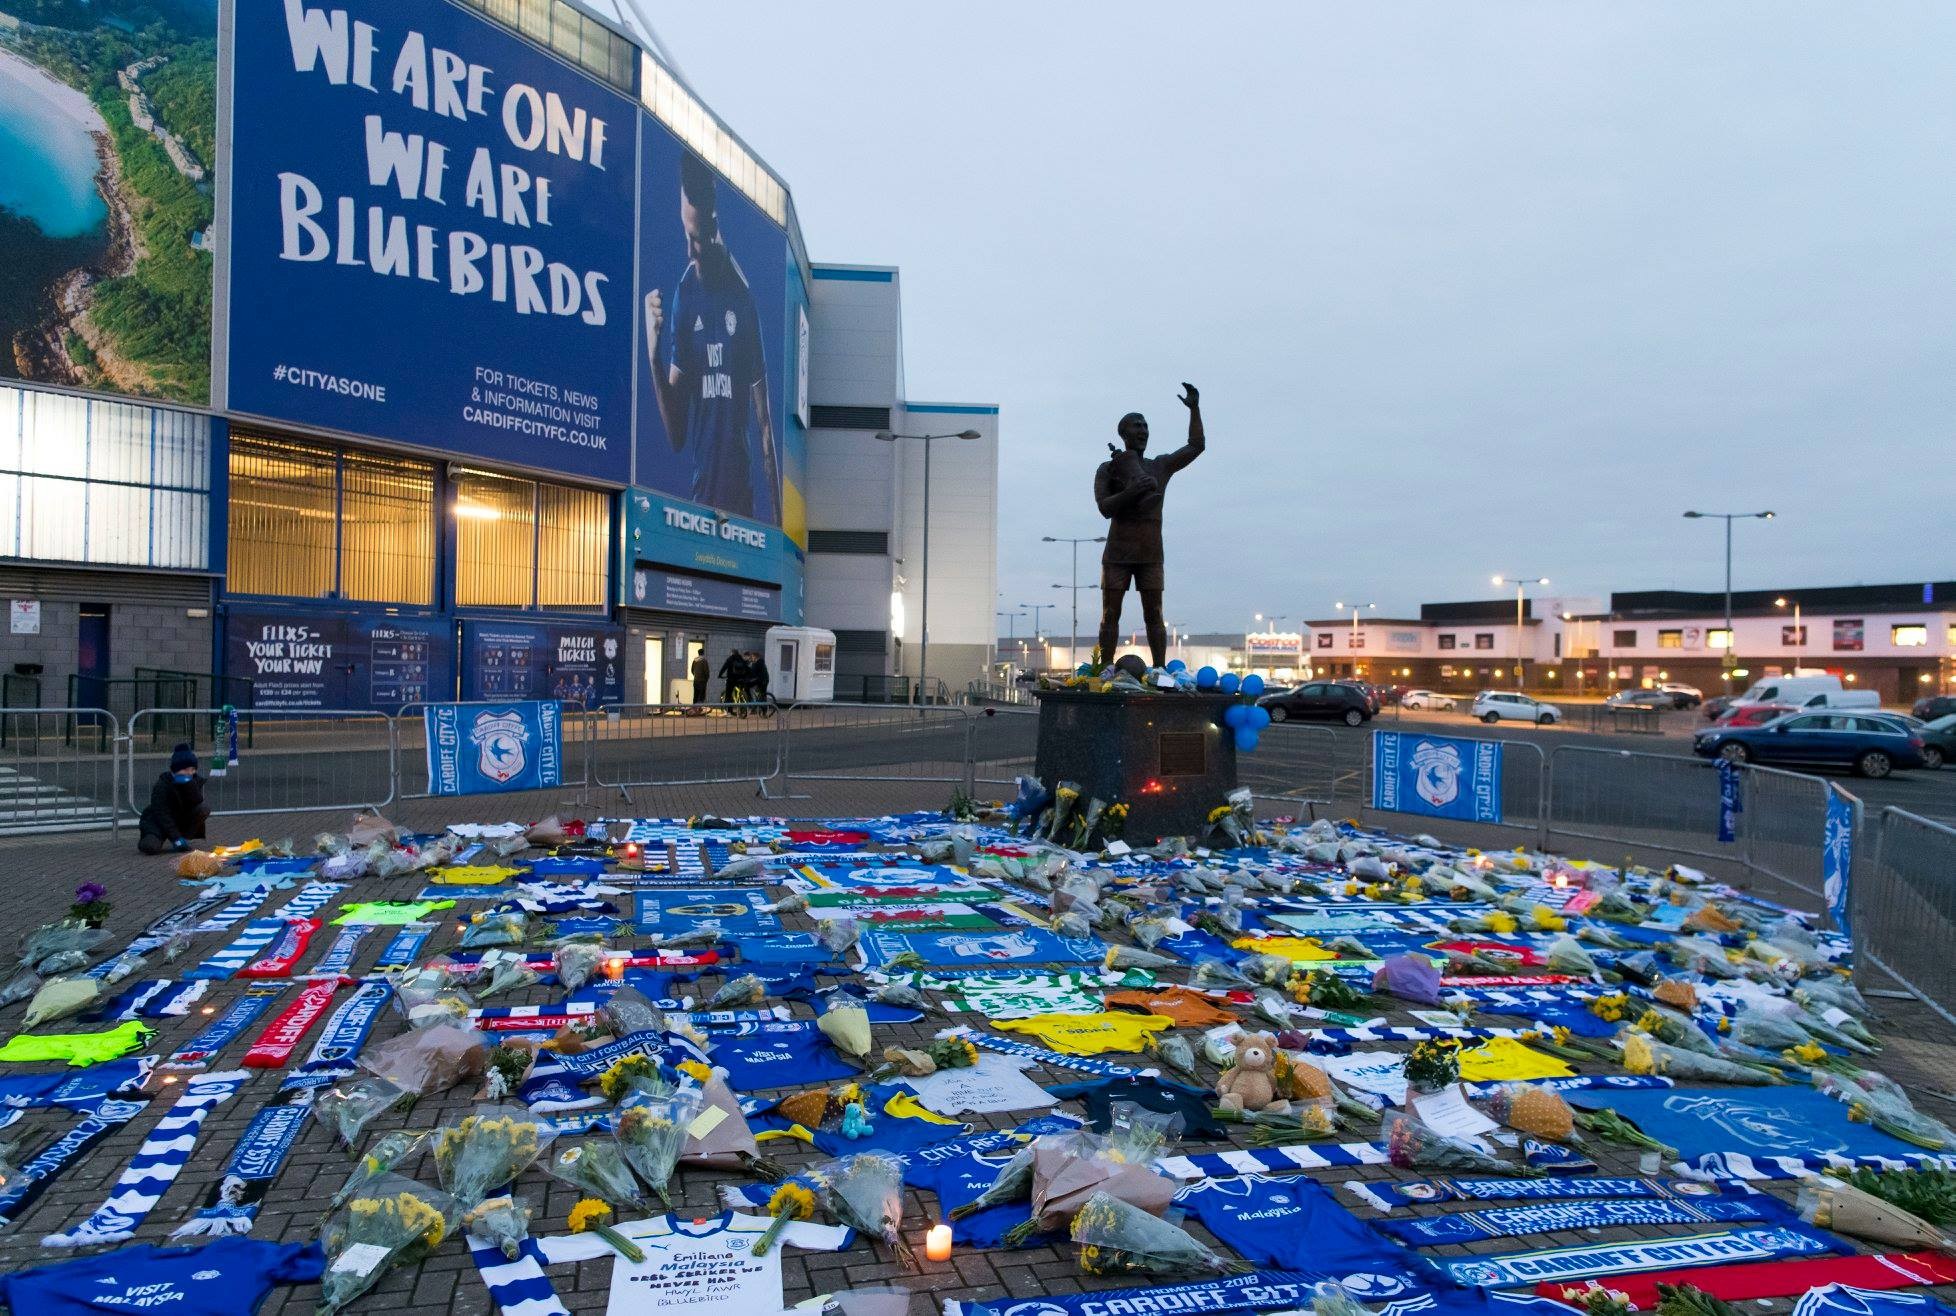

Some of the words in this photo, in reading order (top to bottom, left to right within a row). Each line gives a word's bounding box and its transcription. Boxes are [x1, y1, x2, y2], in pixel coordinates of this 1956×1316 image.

[284, 0, 380, 92] WE
[392, 30, 495, 121] ARE
[502, 83, 609, 171] ONE
[365, 115, 451, 204] WE
[466, 147, 553, 228] ARE
[278, 172, 610, 326] BLUEBIRDS
[272, 364, 386, 403] #CITYASONE
[475, 366, 502, 386] FOR
[505, 373, 560, 401] TICKETS,
[564, 384, 599, 411] NEWS
[471, 386, 482, 403] &
[485, 389, 571, 424] INFORMATION
[571, 408, 602, 431] VISIT
[462, 405, 608, 452] CARDIFFCITYFC.CO.UK
[663, 507, 717, 536] TICKET
[721, 523, 766, 549] OFFICE
[246, 641, 284, 657] YOUR
[289, 643, 332, 658] TICKET
[560, 637, 594, 648] MATCH
[254, 658, 291, 674] YOUR
[294, 660, 323, 675] WAY
[557, 648, 596, 662] TICKETS
[438, 708, 453, 721] FC
[439, 722, 455, 745] CITY
[1384, 734, 1397, 746] FC
[543, 745, 555, 769] CITY
[1385, 746, 1397, 769] CITY
[1478, 743, 1493, 782] CARDIFF
[441, 748, 456, 792] CARDIFF
[543, 768, 555, 784] FC
[1383, 770, 1396, 808] CARDIFF
[1477, 783, 1491, 804] CITY
[1481, 805, 1492, 819] FC
[221, 998, 263, 1028] CARDIFF
[274, 994, 327, 1043] CARDIFF
[192, 1030, 229, 1049] CITY
[577, 1052, 597, 1063] CITY
[599, 1033, 645, 1058] FOOTBALL
[745, 1053, 792, 1063] MALAYSIA
[254, 1107, 299, 1147] CARDIFF
[919, 1143, 966, 1162] CITY
[968, 1135, 1001, 1150] AFC
[237, 1148, 272, 1175] CITY
[1458, 1177, 1567, 1193] CARDIFF
[1571, 1179, 1639, 1192] CITY
[1237, 1206, 1302, 1222] Malaysia
[1488, 1205, 1600, 1225] CARDIFF
[1604, 1202, 1674, 1215] CITY
[660, 1260, 745, 1271] Malaysia
[1510, 1250, 1645, 1277] CARDIFF
[1646, 1241, 1715, 1262] CITY
[1710, 1238, 1749, 1257] FC
[126, 1283, 175, 1297] VISIT
[707, 1277, 736, 1285] HAD
[1140, 1282, 1219, 1296] PROMOTED
[1222, 1274, 1259, 1289] 2018
[92, 1292, 184, 1307] MALAYSIA
[1080, 1289, 1228, 1316] CARDIFF
[1241, 1282, 1327, 1300] CITY
[1199, 1298, 1293, 1313] PREMIERSHIP
